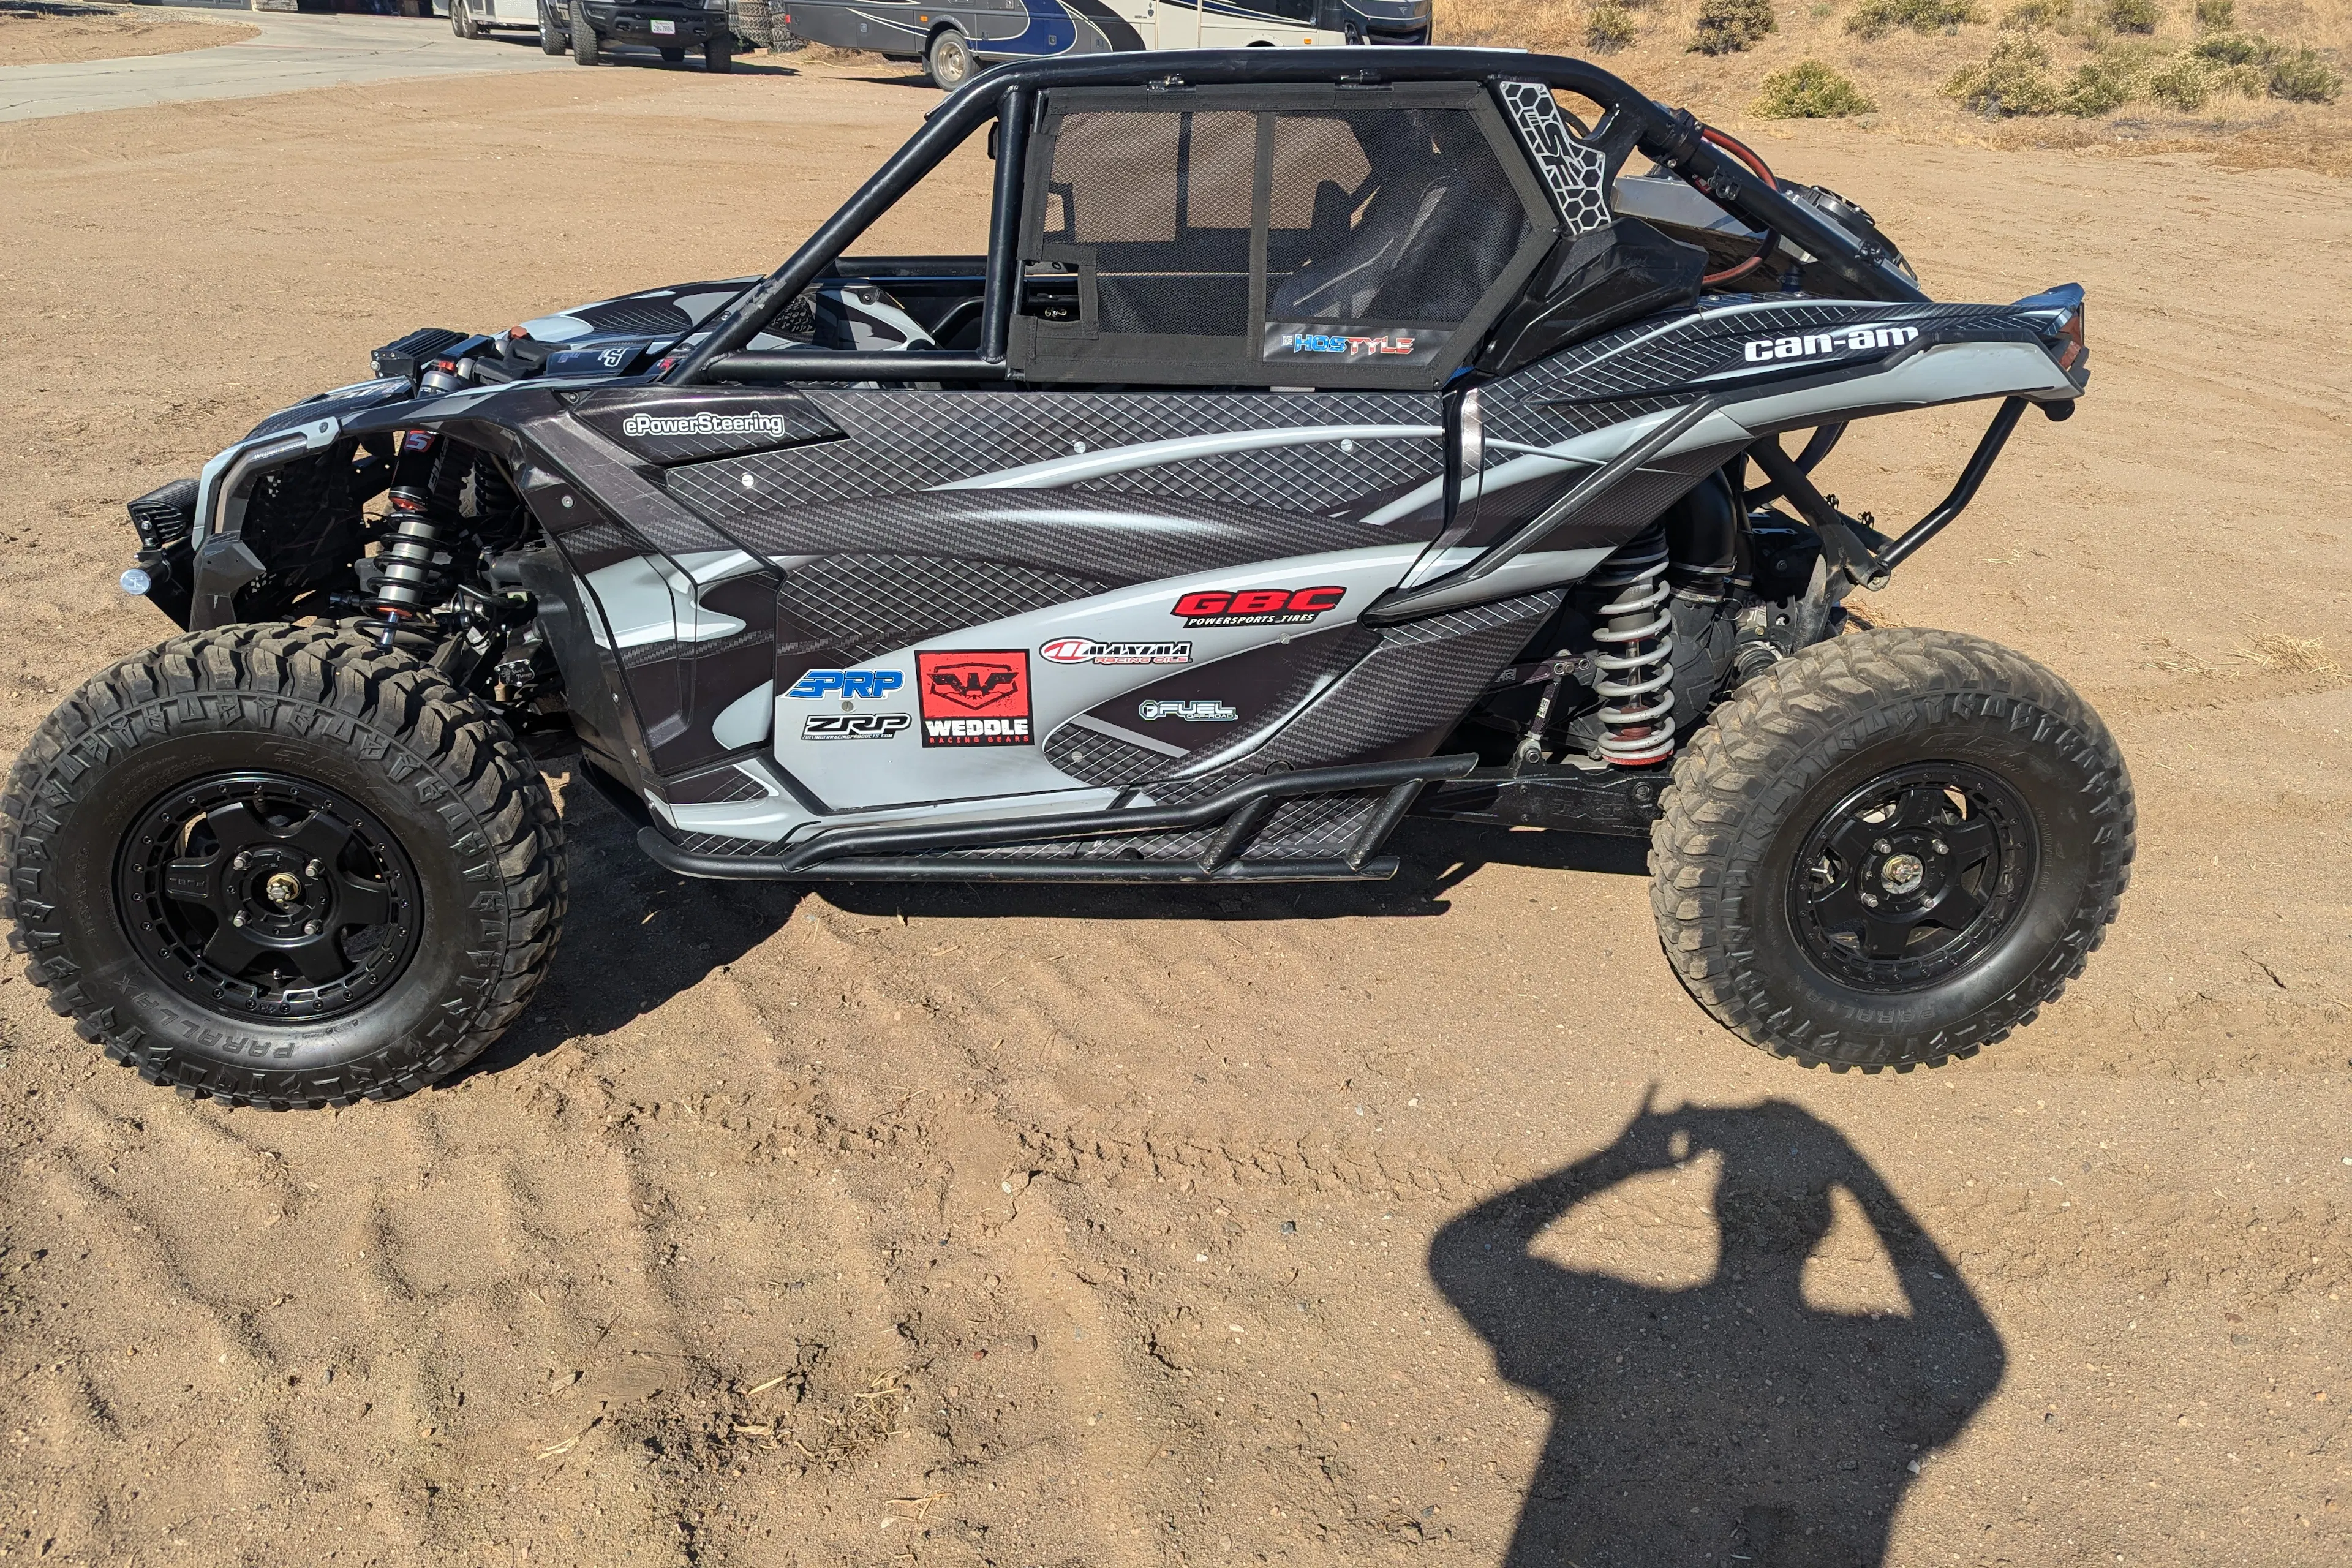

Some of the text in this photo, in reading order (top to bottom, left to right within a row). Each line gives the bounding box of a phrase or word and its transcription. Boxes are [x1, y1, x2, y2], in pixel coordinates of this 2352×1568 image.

[1294, 334, 1415, 355] HOSTYLE
[1744, 326, 1919, 362] can-am
[624, 412, 783, 435] ePowerSteering
[1174, 588, 1344, 615] GBC
[1188, 614, 1314, 626] POWERSPORTS TIRES
[785, 670, 904, 698] PRP
[1159, 703, 1234, 715] FUEL
[807, 715, 908, 732] ZRP
[925, 718, 1028, 736] WEDDLE
[113, 971, 296, 1059] PARALLAX
